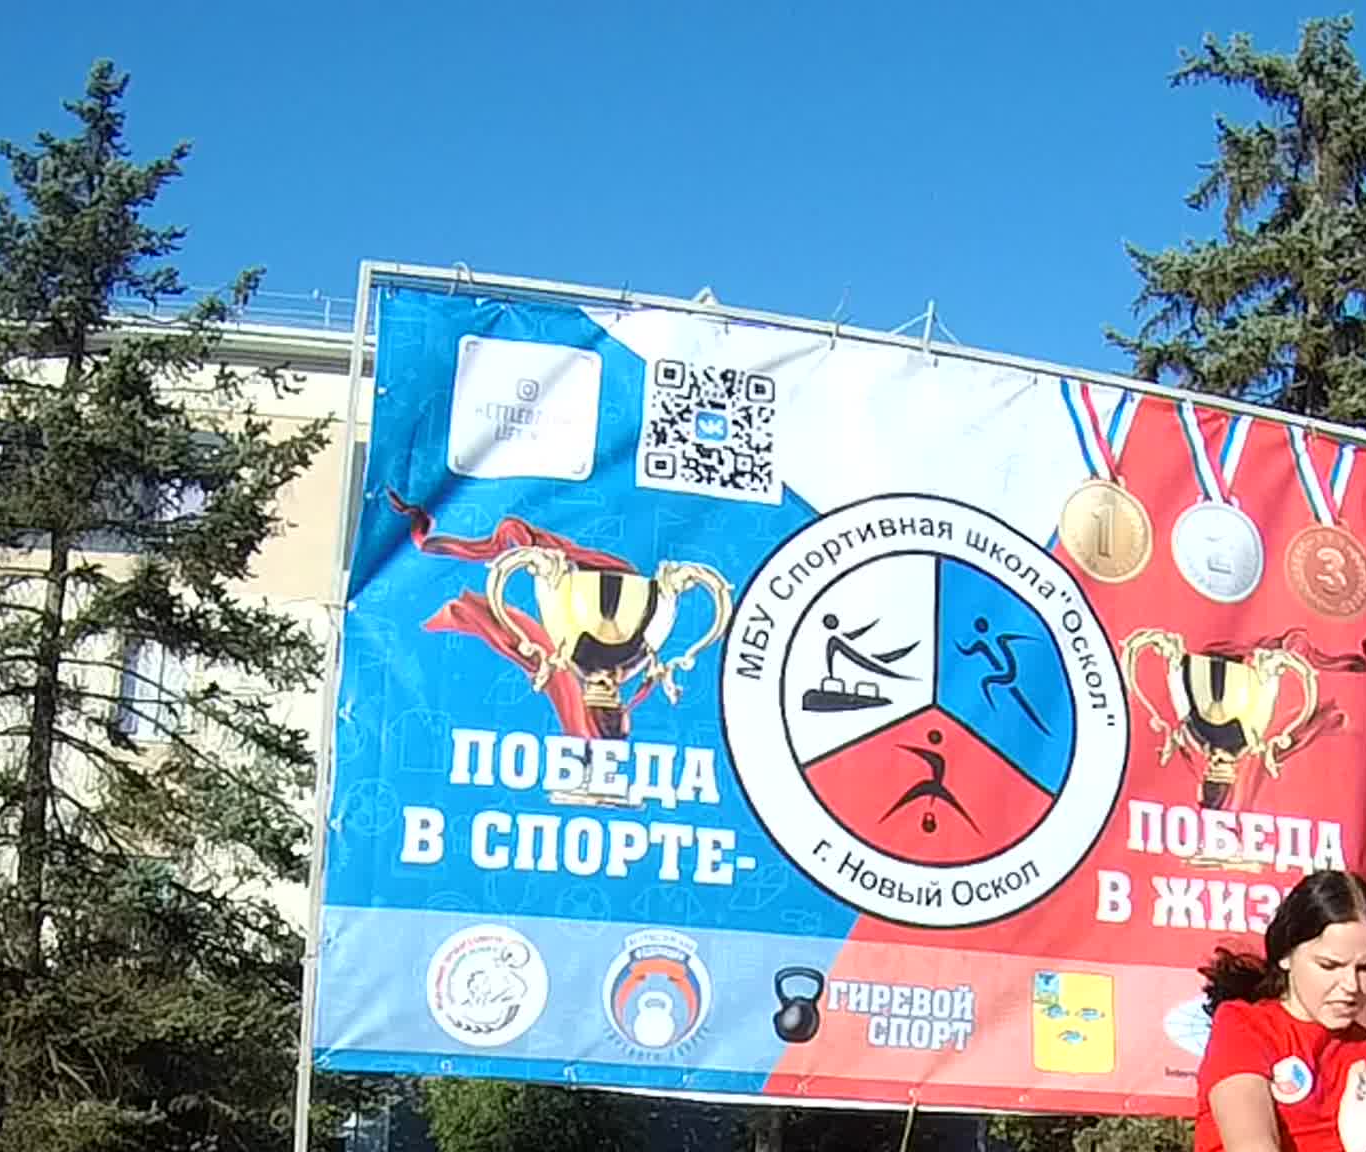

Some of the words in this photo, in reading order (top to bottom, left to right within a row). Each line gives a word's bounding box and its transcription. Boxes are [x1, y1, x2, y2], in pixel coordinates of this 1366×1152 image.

[736, 603, 775, 680] МБУ
[769, 517, 953, 600] Спортивная
[966, 528, 1056, 599] школа
[449, 727, 720, 808] ПОБЕДА
[400, 805, 445, 864] В
[471, 810, 756, 885] СПОРТЕ-
[1127, 799, 1346, 874] ПОБЕДА
[812, 839, 832, 862] г.
[837, 851, 942, 907] Новый
[951, 860, 1040, 906] Оскол
[1096, 869, 1132, 923] В
[1151, 876, 1288, 936] ЖИЗ
[827, 980, 974, 1020] ГИРЕВОЙ
[868, 1015, 972, 1051] СПОРТ
